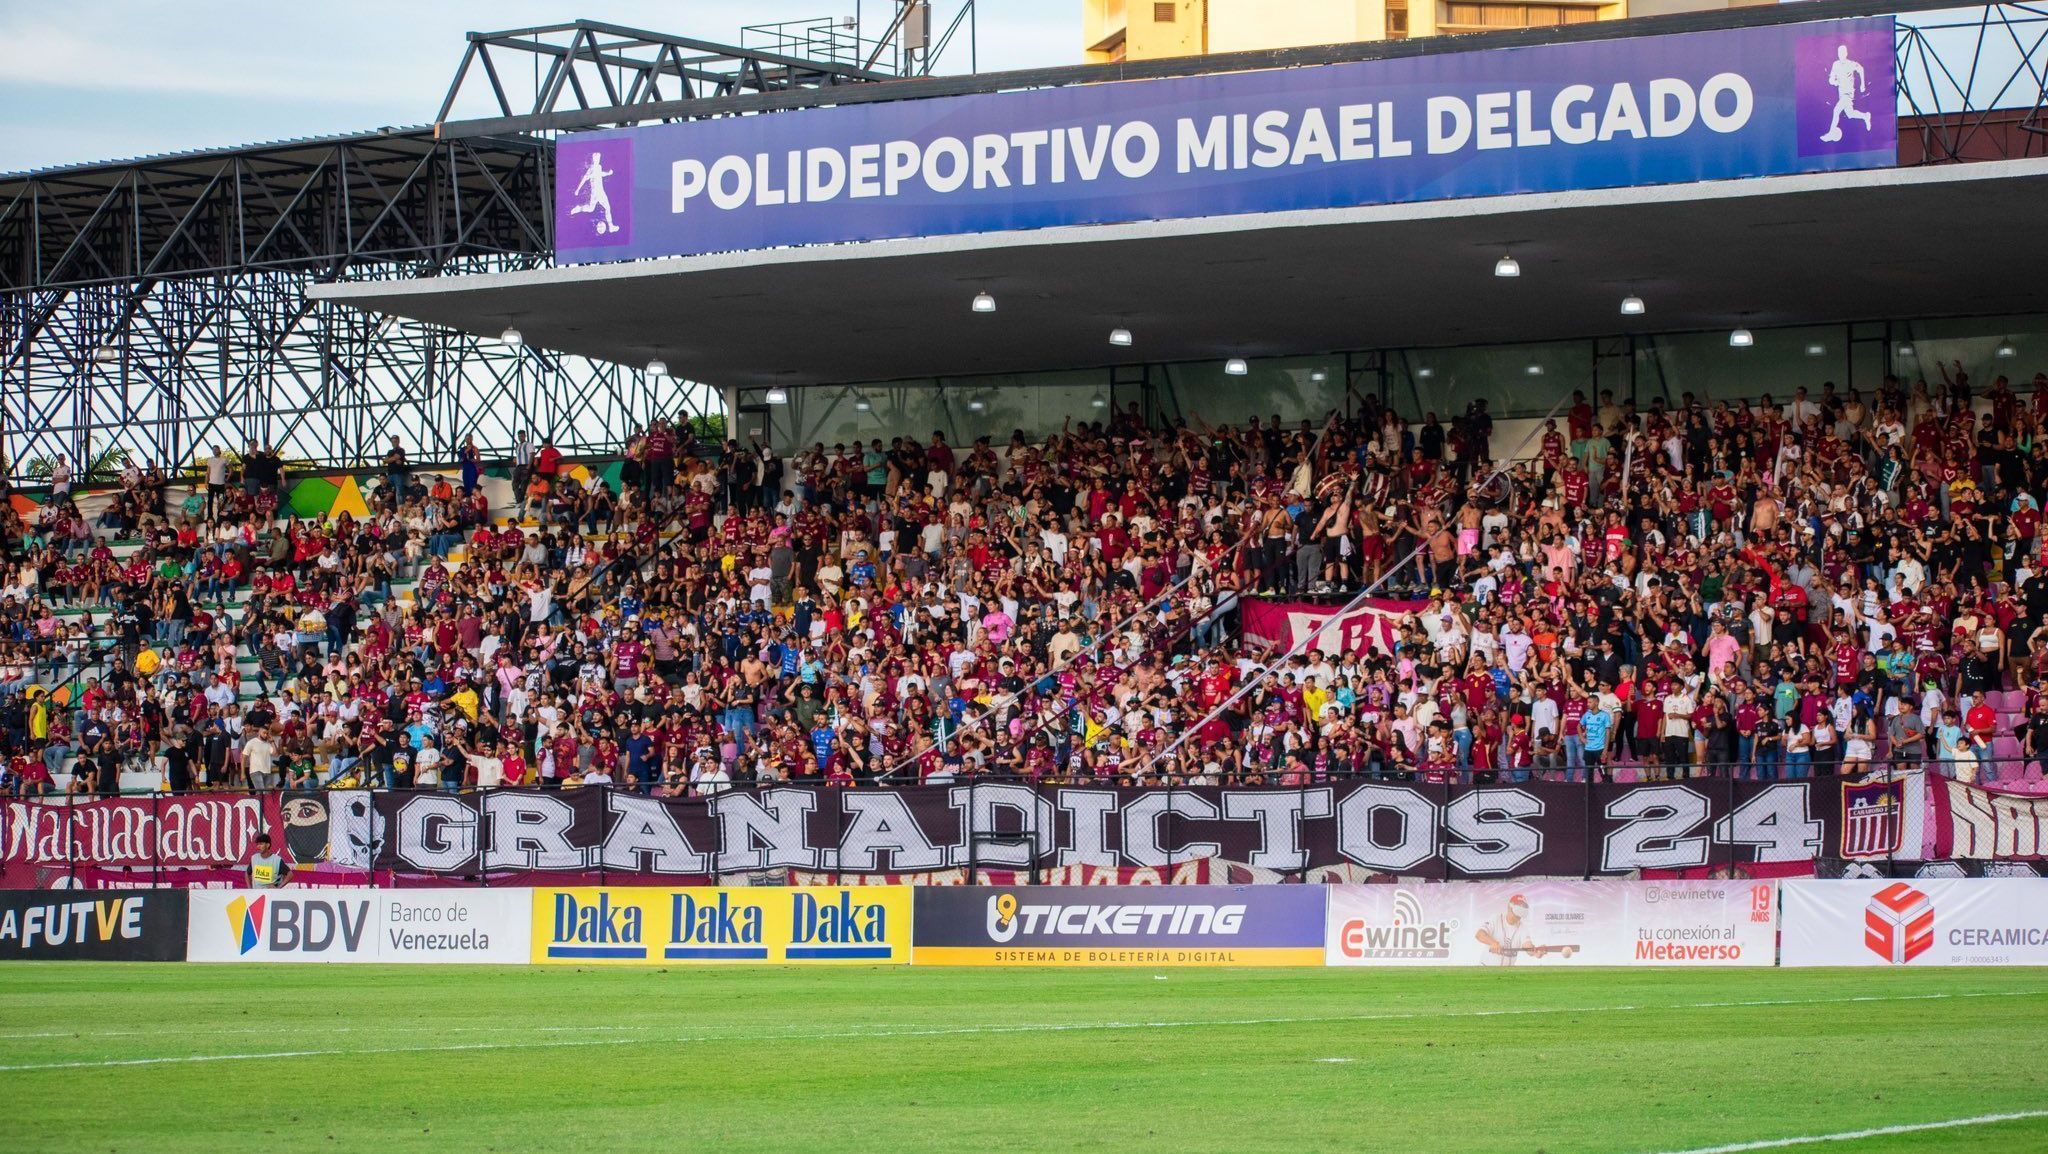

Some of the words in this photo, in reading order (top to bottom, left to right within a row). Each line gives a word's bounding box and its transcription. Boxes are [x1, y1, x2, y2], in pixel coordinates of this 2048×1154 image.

[671, 120, 1160, 213] POLIDEPORTIVO
[1177, 101, 1412, 173] MISAEL
[1427, 73, 1753, 154] DELGADO
[396, 784, 1546, 874] GRANADICTOS
[1601, 783, 1824, 871] 24
[1660, 887, 1725, 900] @ewinetve
[1750, 885, 1771, 911] 19
[22, 897, 144, 948] FUTVE
[269, 900, 370, 953] BDV
[390, 902, 441, 922] Banco
[446, 902, 468, 922] de
[552, 892, 642, 943] Daka
[668, 892, 763, 944] Daka
[790, 890, 886, 944] Daka
[1750, 911, 1770, 923] AÑOS
[389, 928, 489, 950] Venezuela
[1341, 919, 1450, 958] Ewinet
[1638, 927, 1653, 941] tu
[1656, 924, 1721, 941] conexión
[1724, 923, 1736, 940] al
[995, 951, 1056, 962] SISTEMA
[1064, 952, 1081, 962] DE
[1089, 949, 1170, 962] BOLETERÍA
[1178, 952, 1236, 962] DIGITAL
[1635, 940, 1741, 960] Metaverso
